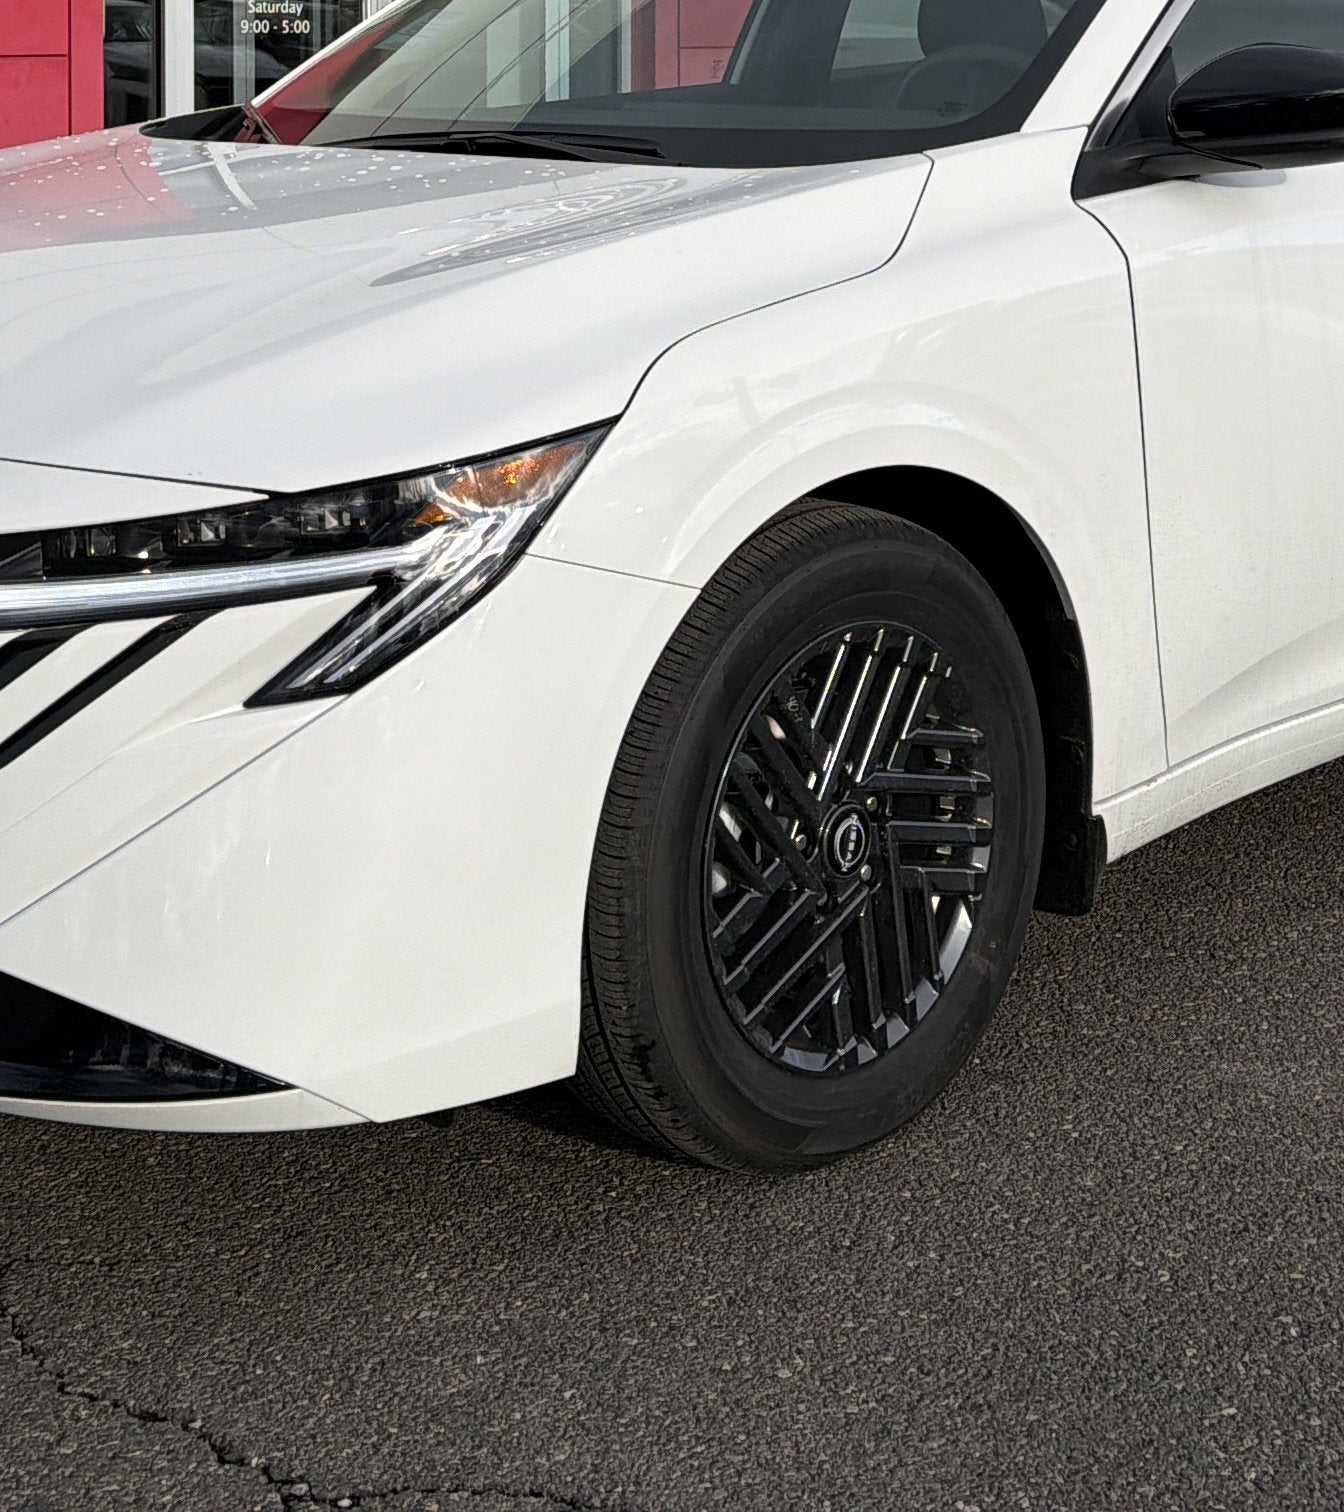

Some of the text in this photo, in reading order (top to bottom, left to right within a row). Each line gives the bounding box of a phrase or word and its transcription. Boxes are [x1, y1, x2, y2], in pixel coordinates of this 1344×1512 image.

[247, 0, 304, 16] Saturday
[240, 20, 270, 33] 9:00
[281, 20, 311, 34] 5:00
